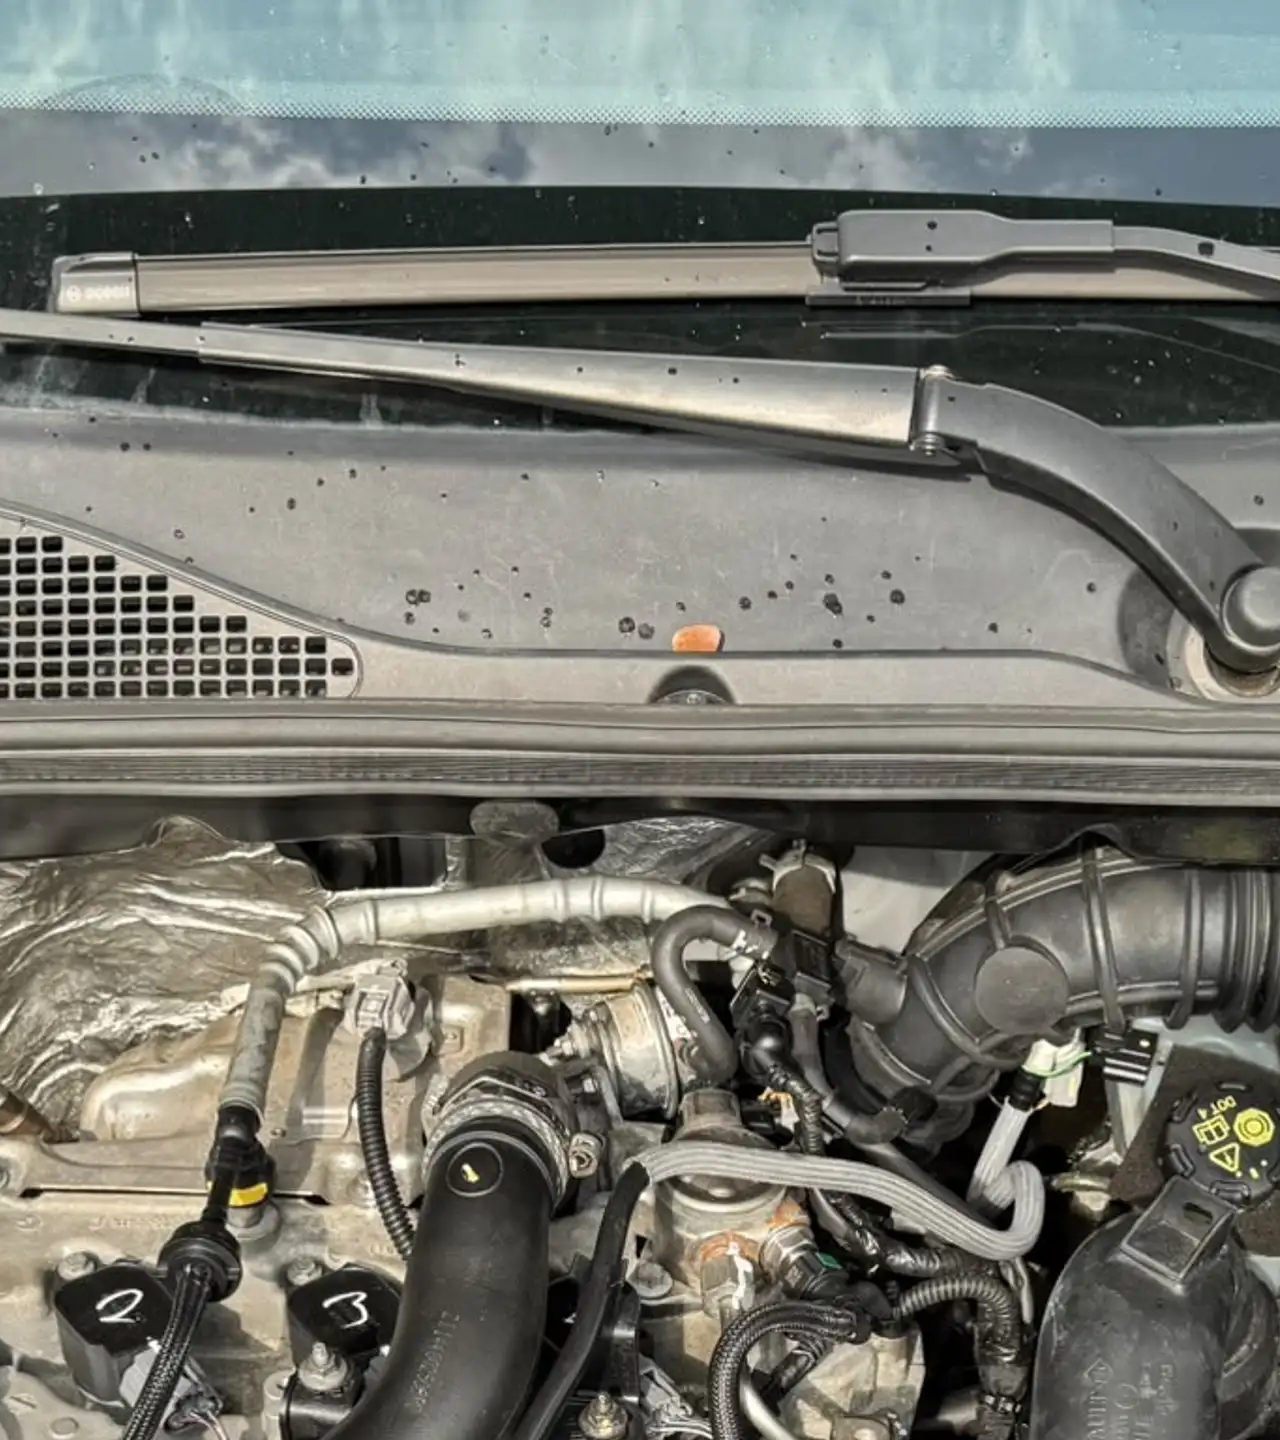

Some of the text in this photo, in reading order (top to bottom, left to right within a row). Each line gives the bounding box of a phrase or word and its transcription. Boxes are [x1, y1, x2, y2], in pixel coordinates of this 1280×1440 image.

[1196, 1094, 1237, 1120] DOT 4
[95, 1288, 145, 1324] 2
[322, 1291, 370, 1330] 3
